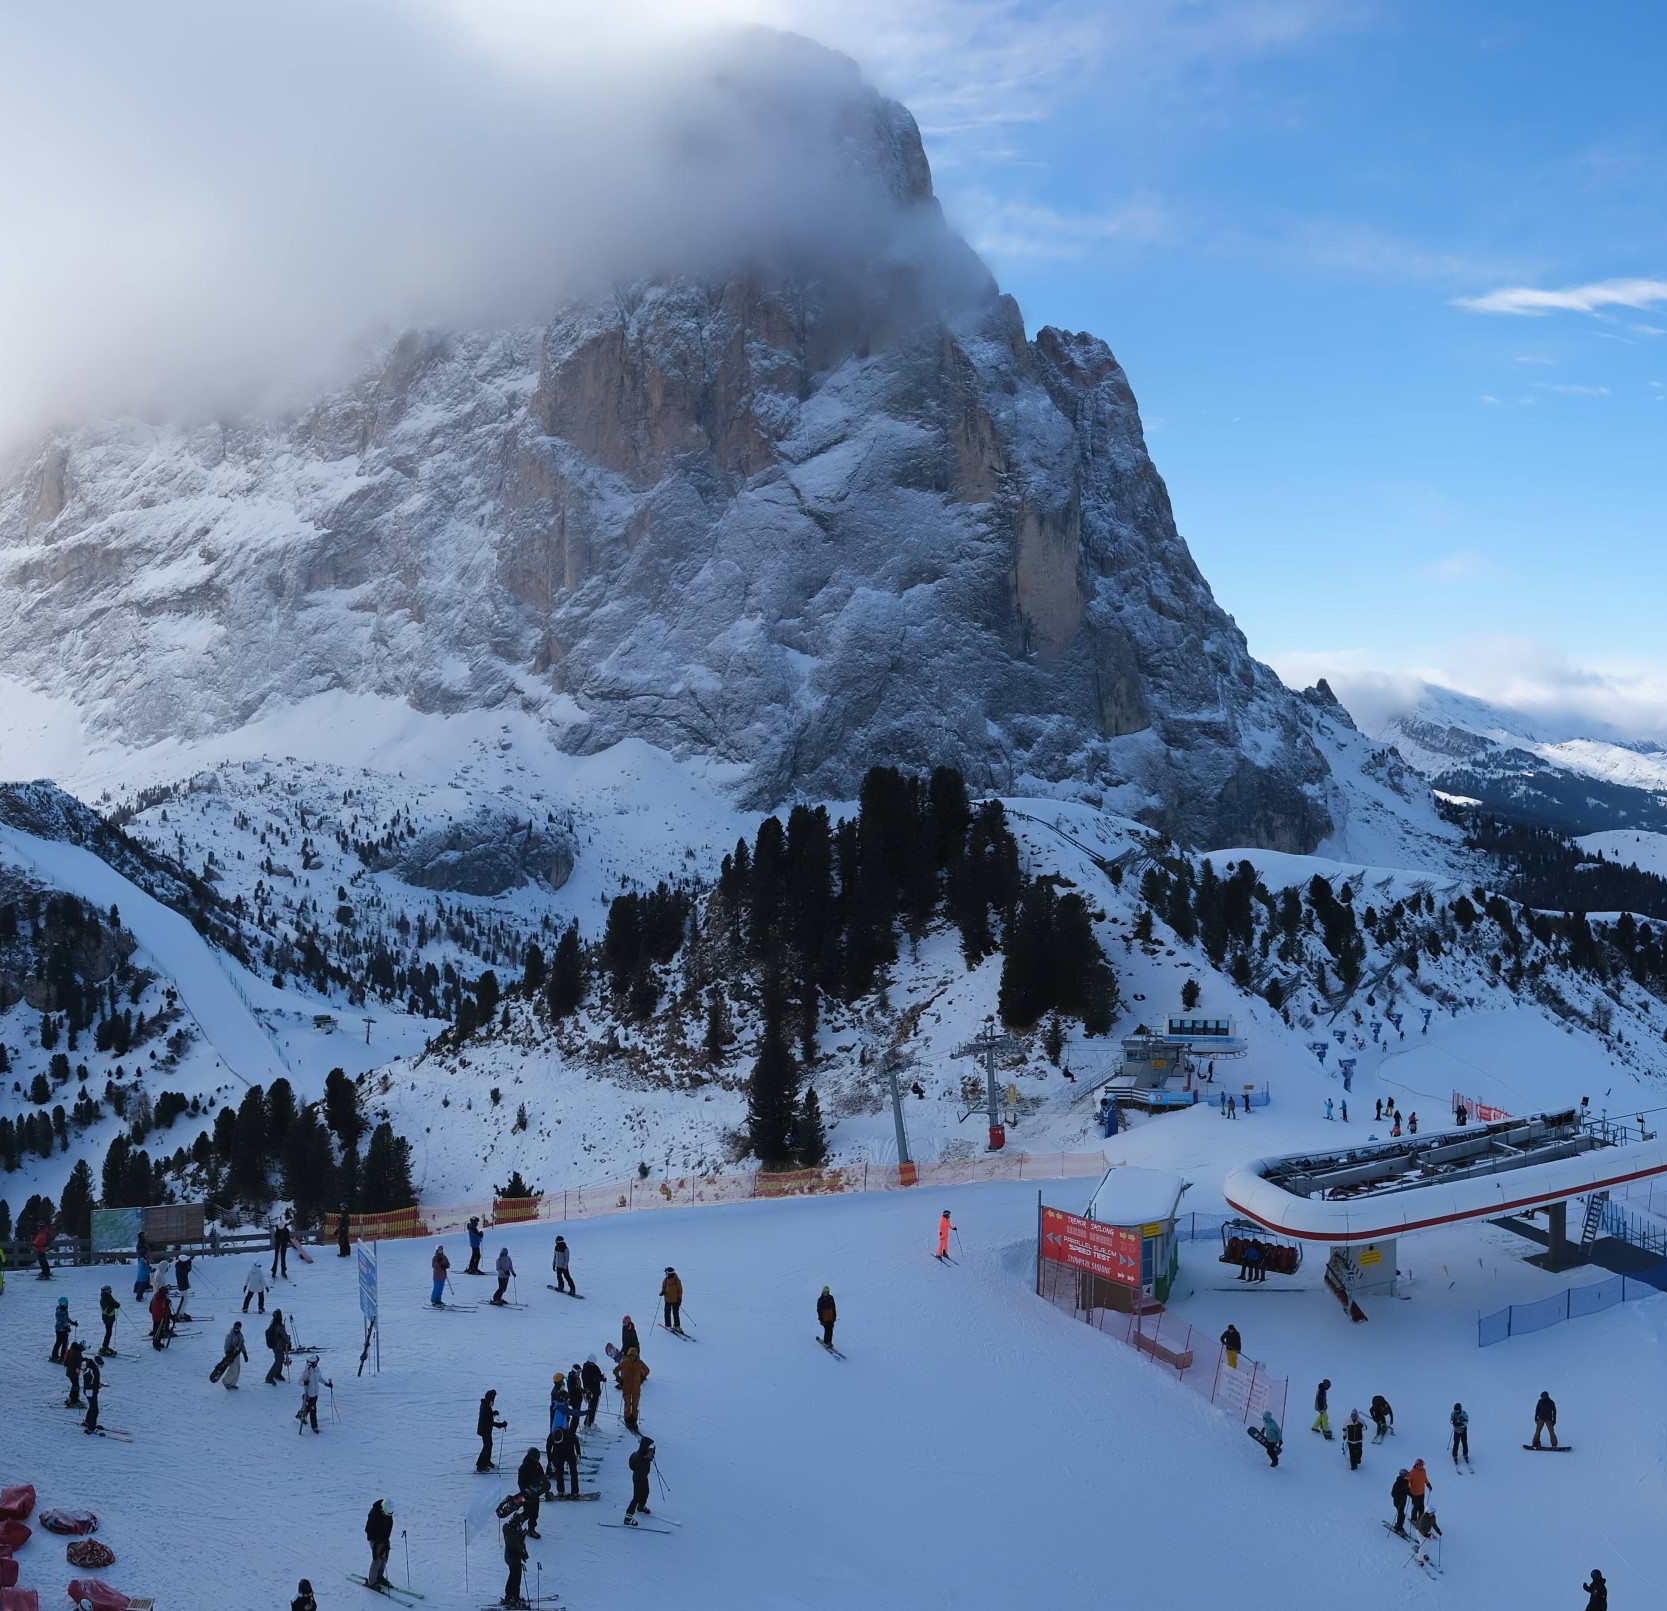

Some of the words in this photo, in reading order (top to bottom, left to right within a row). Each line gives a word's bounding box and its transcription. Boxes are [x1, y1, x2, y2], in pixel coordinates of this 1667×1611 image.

[1068, 1216, 1087, 1229] TREMOR
[1091, 1223, 1115, 1236] SASLONG
[1064, 1236, 1092, 1249] PARALLEL
[1093, 1245, 1116, 1257] SLALOM
[1068, 1244, 1091, 1256] SPEED
[1093, 1252, 1111, 1261] TEST
[1067, 1255, 1090, 1268] SNOWPARK
[1091, 1262, 1111, 1274] SASLONG
